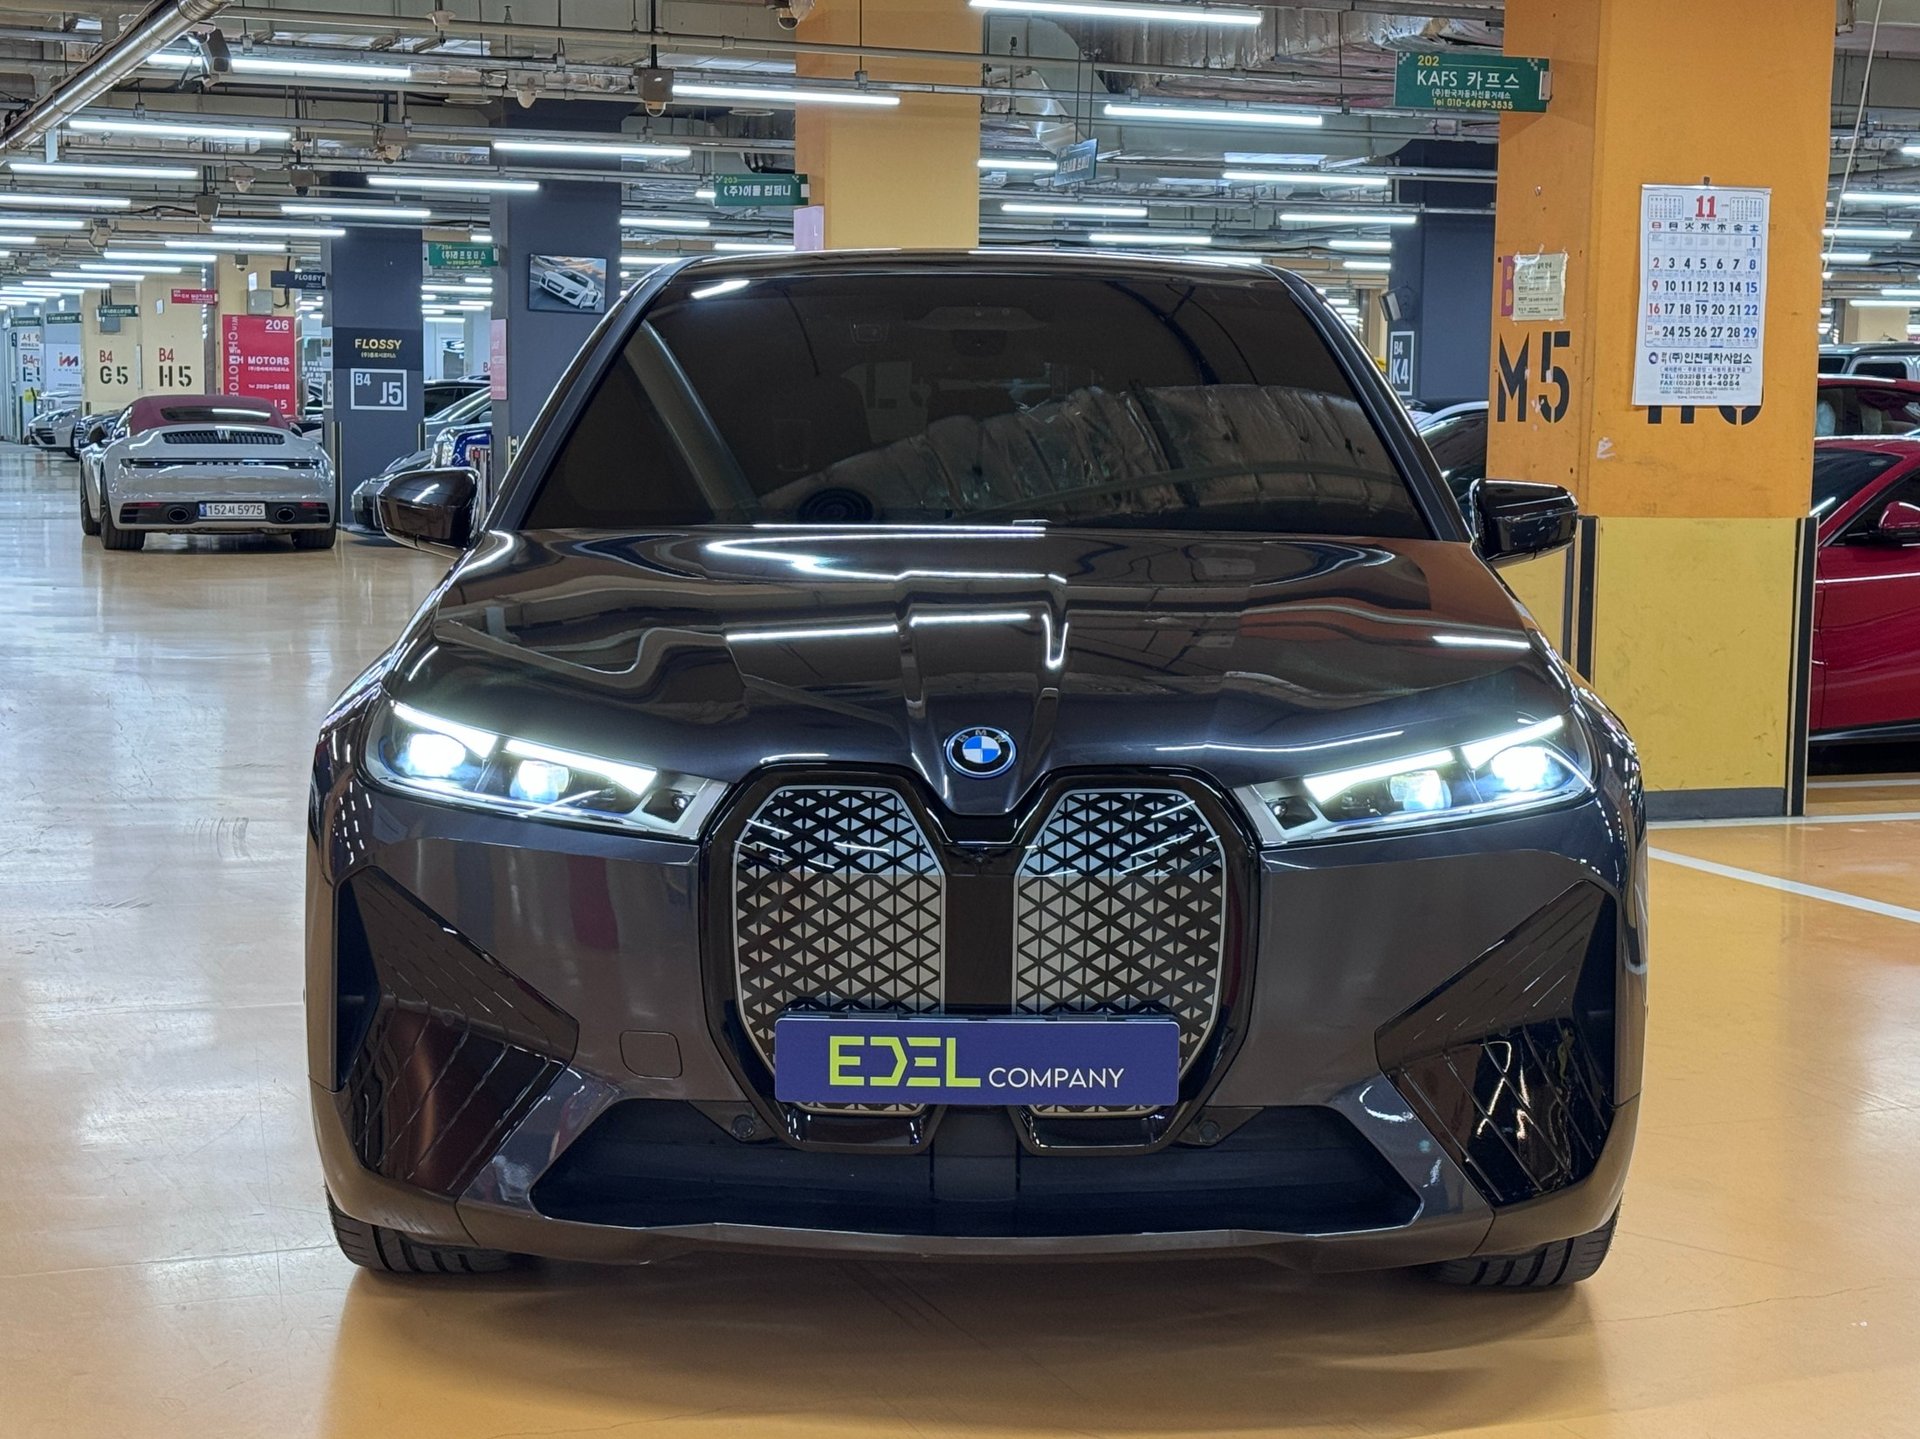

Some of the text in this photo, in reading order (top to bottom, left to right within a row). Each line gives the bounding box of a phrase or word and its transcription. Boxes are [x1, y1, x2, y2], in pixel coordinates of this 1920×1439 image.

[1417, 55, 1440, 66] 202
[1416, 70, 1520, 90] KAFS 카프스
[1446, 99, 1514, 110] 010-6489-3535
[1695, 195, 1717, 218] 11
[1751, 236, 1756, 248] 1
[1653, 257, 1756, 270] 2 3 4 5 6 7 8
[1652, 280, 1758, 293] 9 10 11 12 13 14 15
[1649, 303, 1758, 316] 16 17 18 19 20 21 22
[265, 319, 289, 330] 206
[1662, 326, 1675, 337] 24
[1678, 326, 1691, 338] 25
[1694, 326, 1707, 338] 26
[1710, 326, 1723, 338] 27
[1727, 327, 1740, 338] 28
[1743, 327, 1757, 338] 29
[354, 338, 402, 350] FLOSSY
[1393, 340, 1403, 355] B4
[99, 350, 113, 363] B4
[159, 347, 174, 362] B4
[247, 356, 290, 365] MOTORS
[1669, 352, 1752, 364] (주)인천폐차사업소
[1392, 358, 1409, 384] K4
[1497, 331, 1571, 423] M5
[355, 373, 371, 386] B4
[379, 381, 402, 405] J5
[237, 504, 263, 516] 5975
[956, 729, 1008, 744] BMW
[829, 1035, 1125, 1089] EDEL COMPANY
